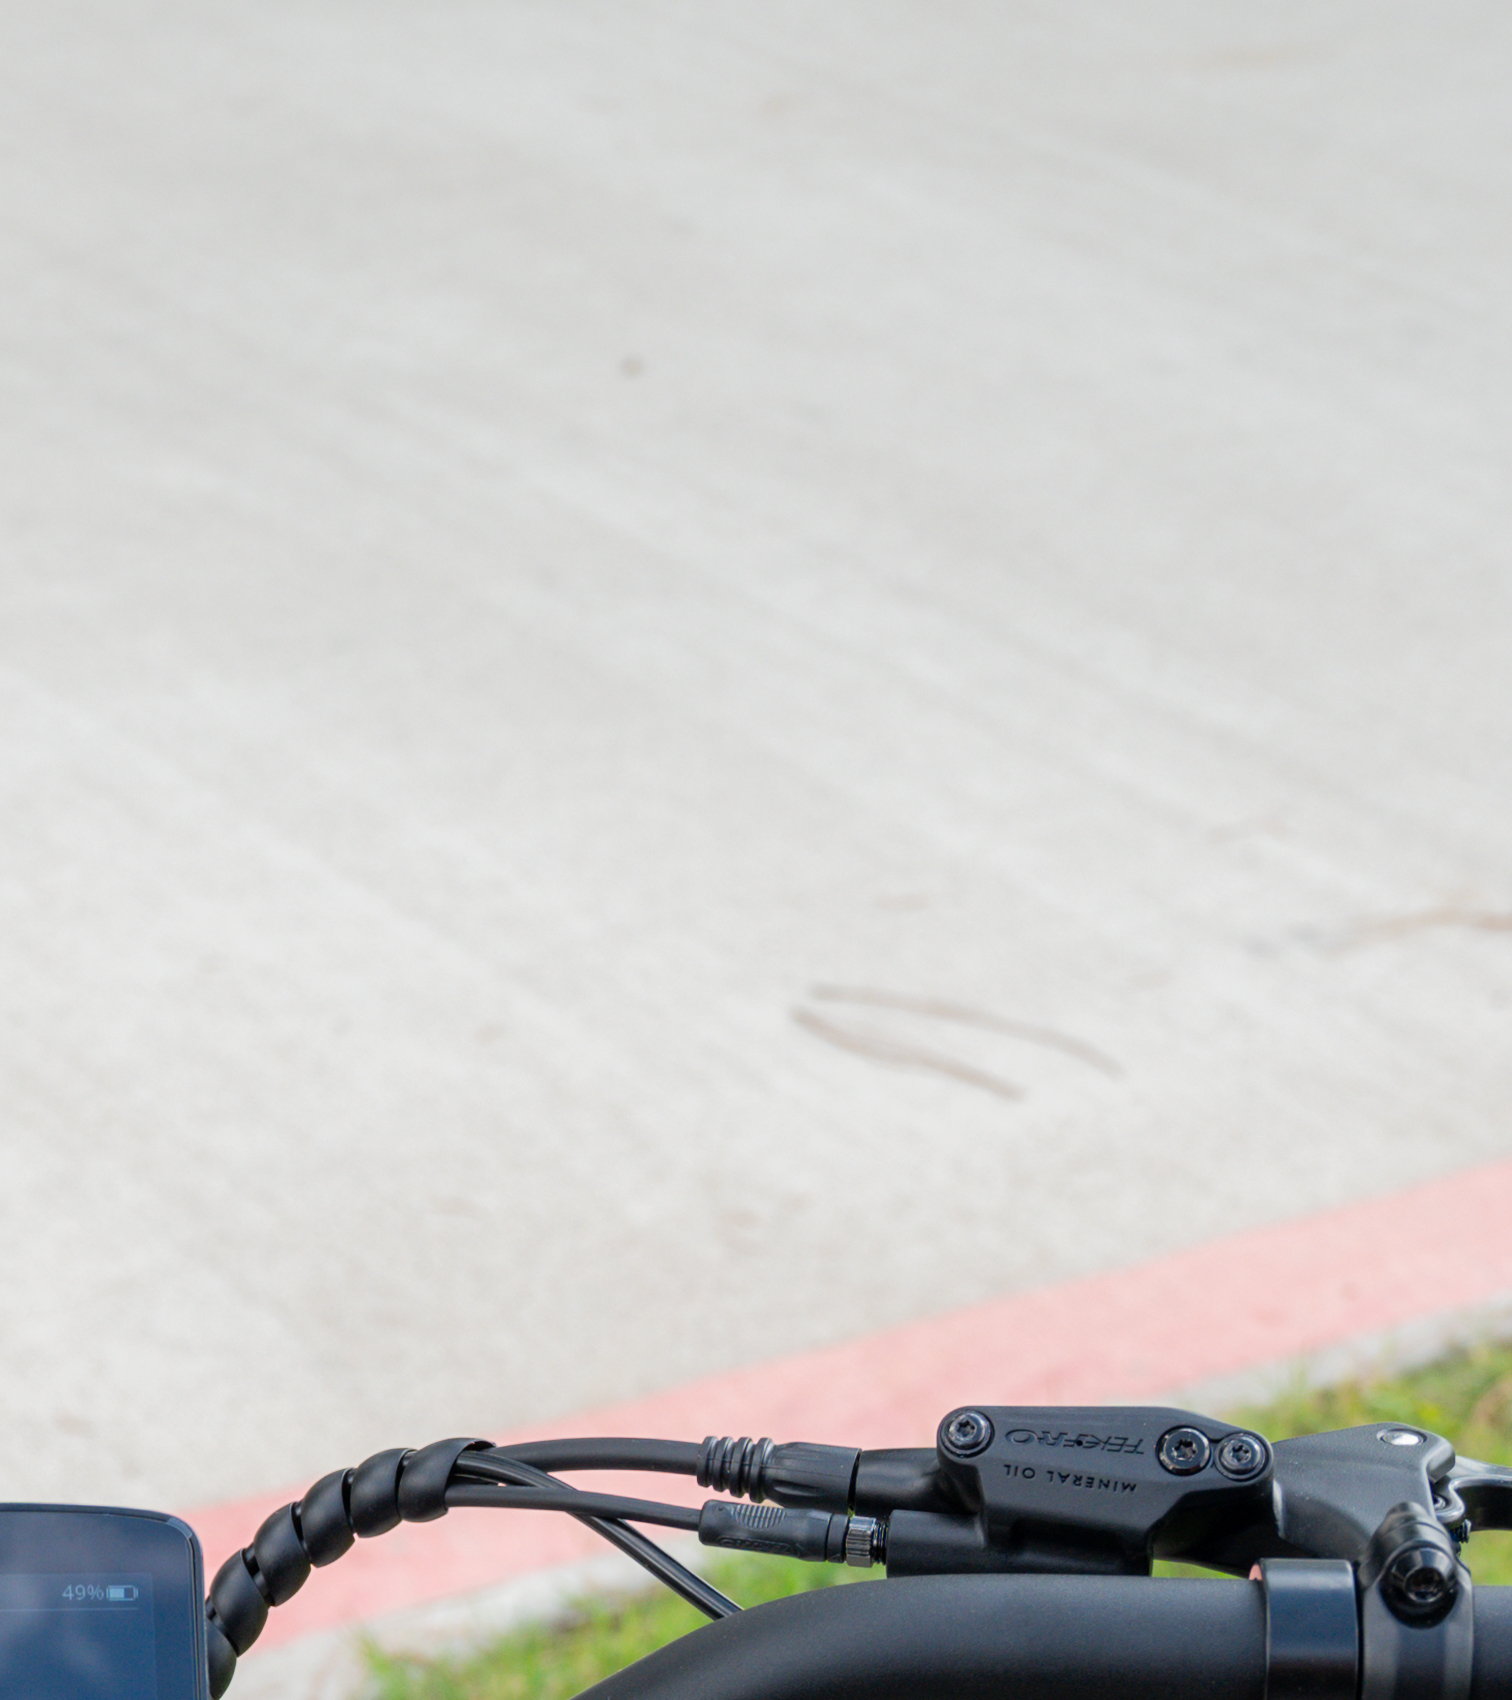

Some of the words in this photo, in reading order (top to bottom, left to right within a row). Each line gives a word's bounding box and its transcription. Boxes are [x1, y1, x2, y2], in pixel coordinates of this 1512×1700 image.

[1003, 1463, 1036, 1479] OIL
[1046, 1470, 1137, 1493] MINERAL
[61, 1584, 105, 1601] 49%
